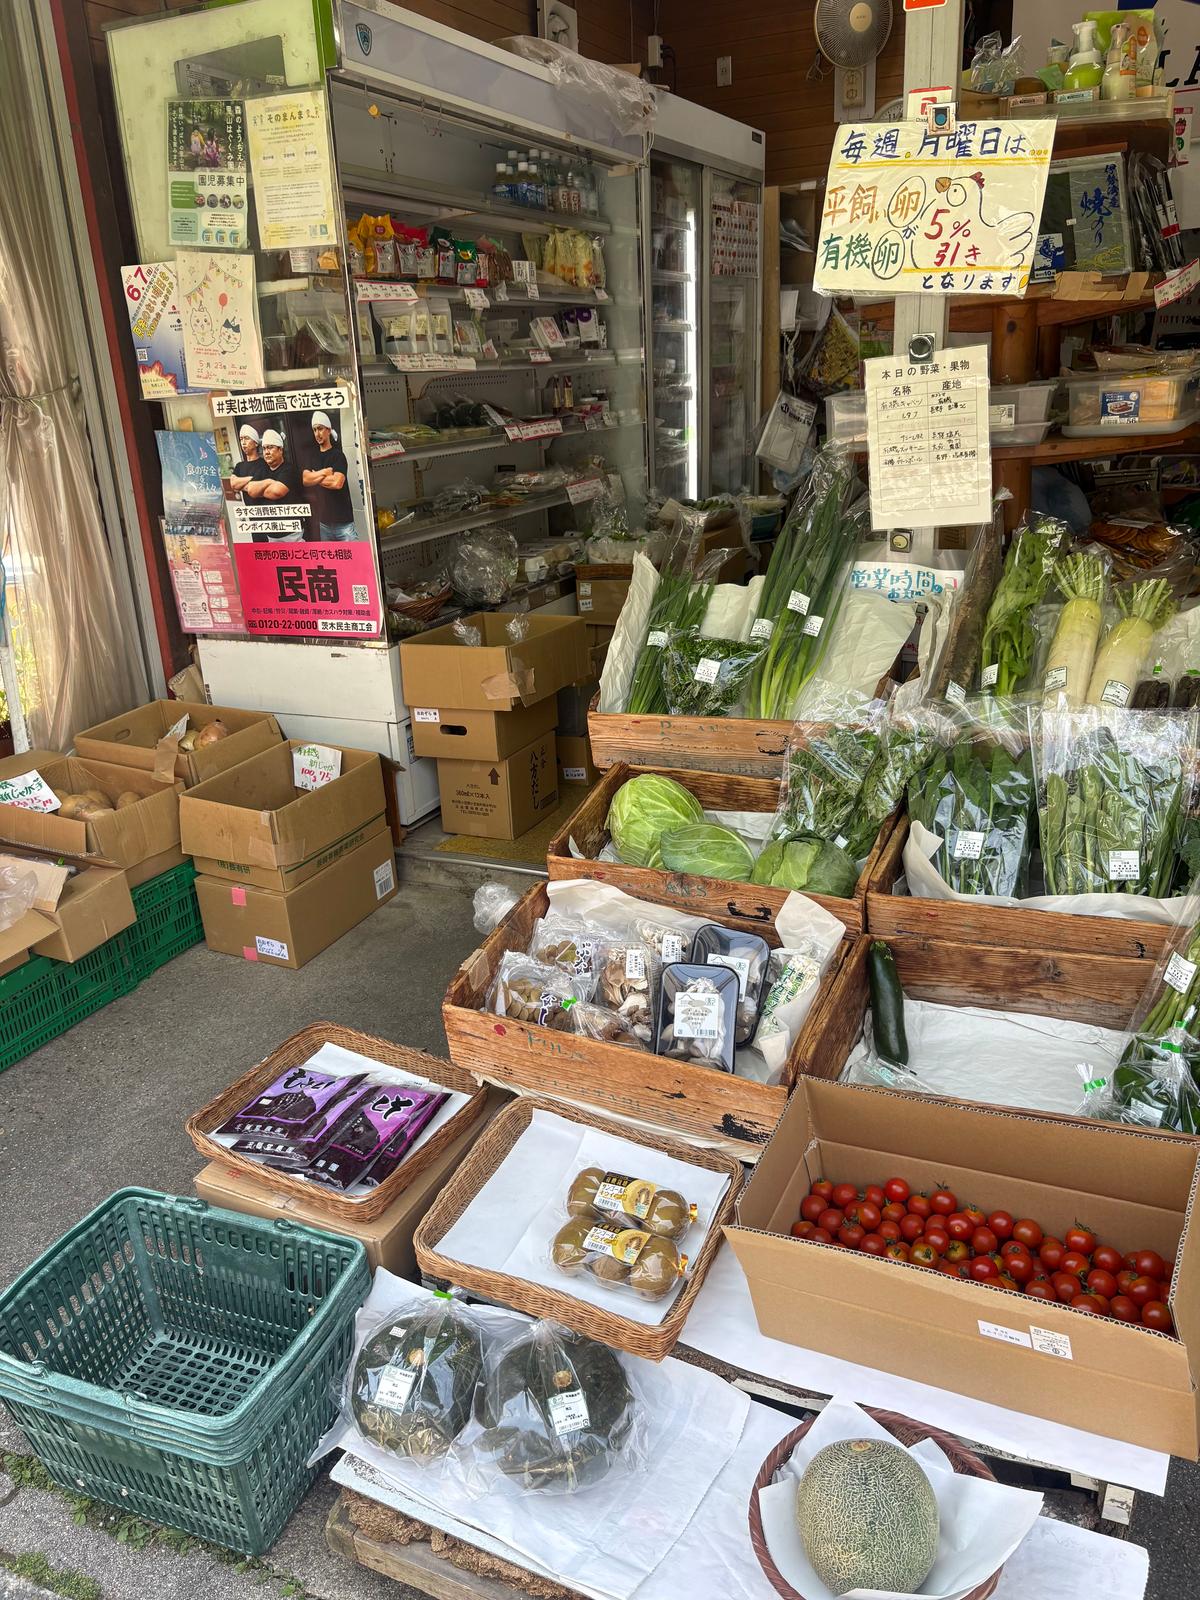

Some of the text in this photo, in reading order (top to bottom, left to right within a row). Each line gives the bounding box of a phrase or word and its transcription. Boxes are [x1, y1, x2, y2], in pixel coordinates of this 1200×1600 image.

[198, 174, 245, 187] 園児募集中
[903, 225, 918, 238] が
[933, 241, 982, 267] 引き
[922, 271, 1016, 292] となります
[881, 360, 970, 379] 本日の野菜・果物
[892, 386, 911, 396] 名称
[942, 381, 962, 391] 産地
[216, 391, 345, 415] #実は物価高で泣きそう
[235, 505, 310, 516] 今すぐ消費税下げてくれ
[238, 521, 300, 531] インボイス廃止一択
[254, 549, 352, 560] 商売の困りごと何でも相談
[276, 565, 340, 603] 民商
[851, 568, 936, 590] 営業時間
[258, 620, 318, 630] 0120-22-0000
[321, 621, 373, 631] 茨木民主商工会
[601, 1184, 628, 1194] サンゴールド
[592, 1228, 619, 1240] サンゴールド
